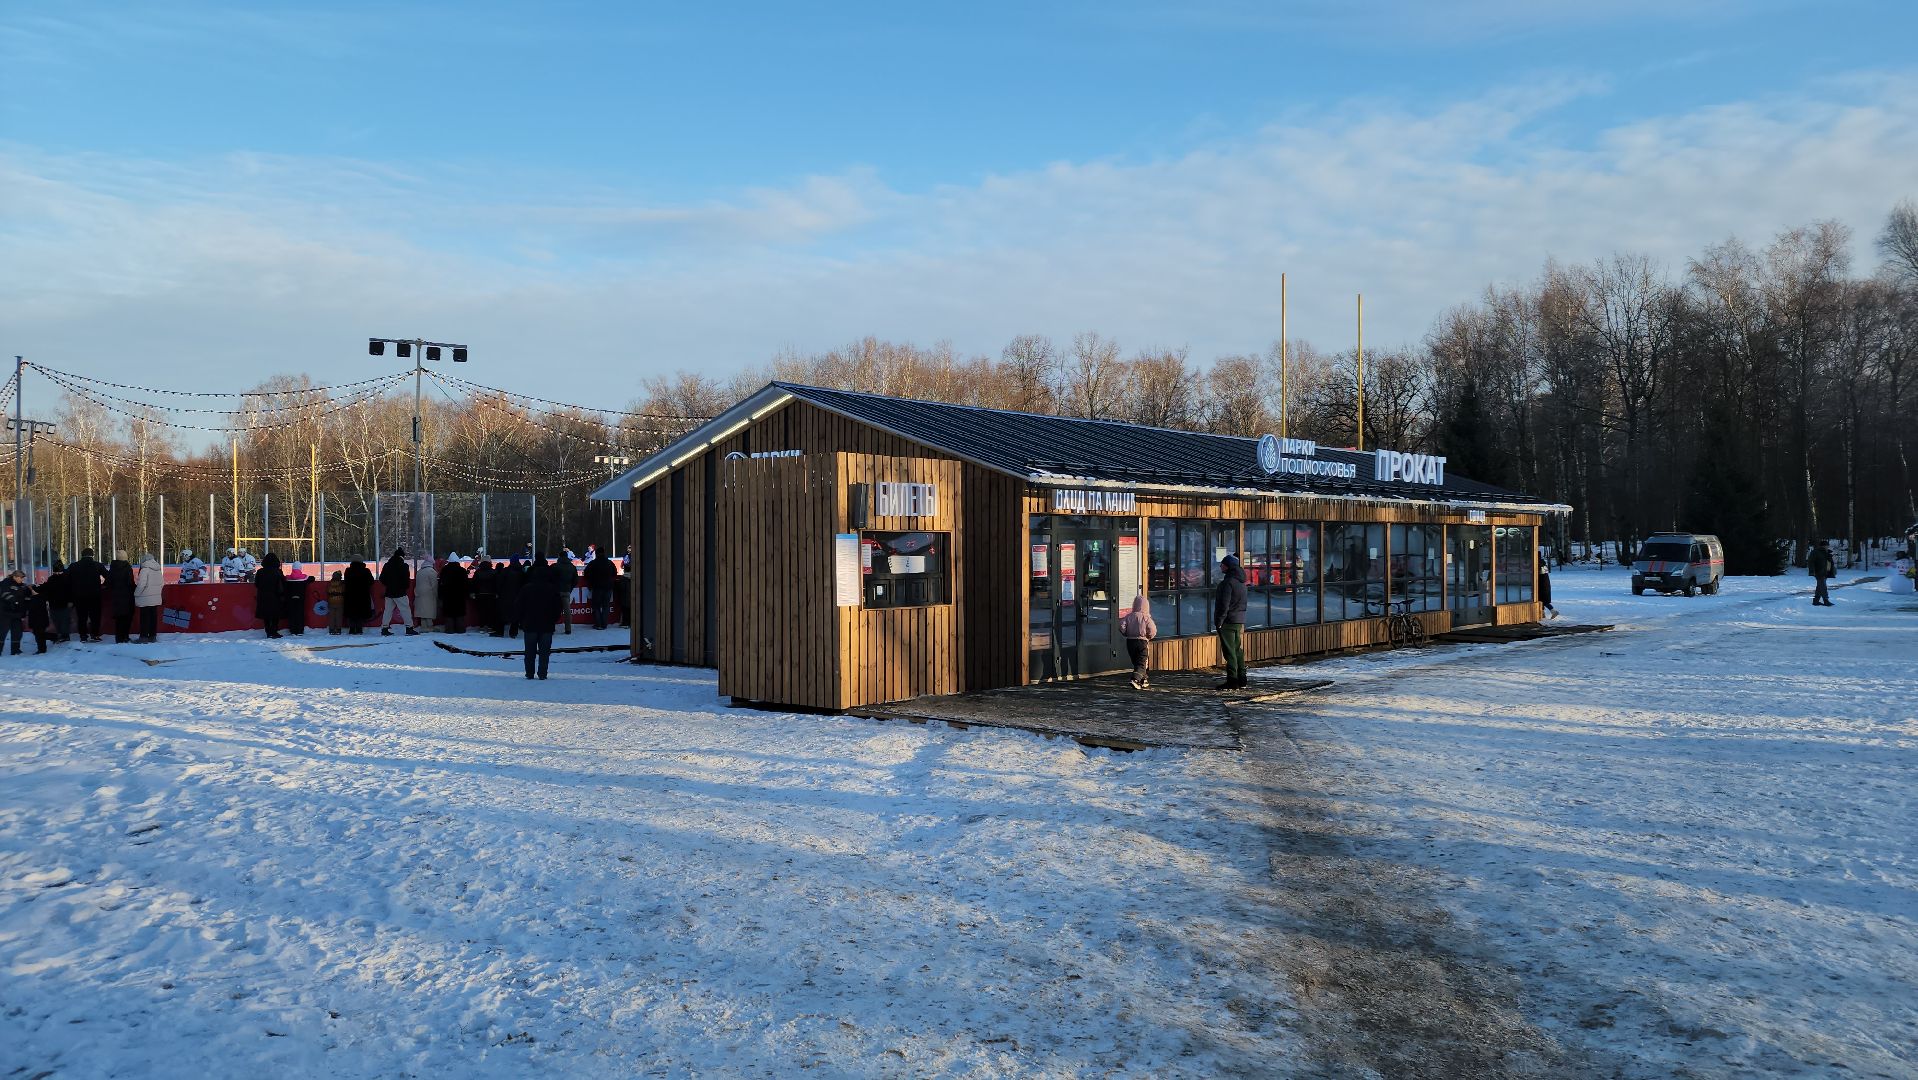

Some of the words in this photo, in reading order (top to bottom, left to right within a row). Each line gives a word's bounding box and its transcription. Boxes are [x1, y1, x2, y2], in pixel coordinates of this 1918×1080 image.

[1281, 438, 1316, 456] ПАРКИ
[1281, 457, 1356, 479] ПОДМОСКОВЬЯ
[1375, 449, 1447, 486] ПРОКАТ
[876, 482, 938, 516] БИЛЕТЫ
